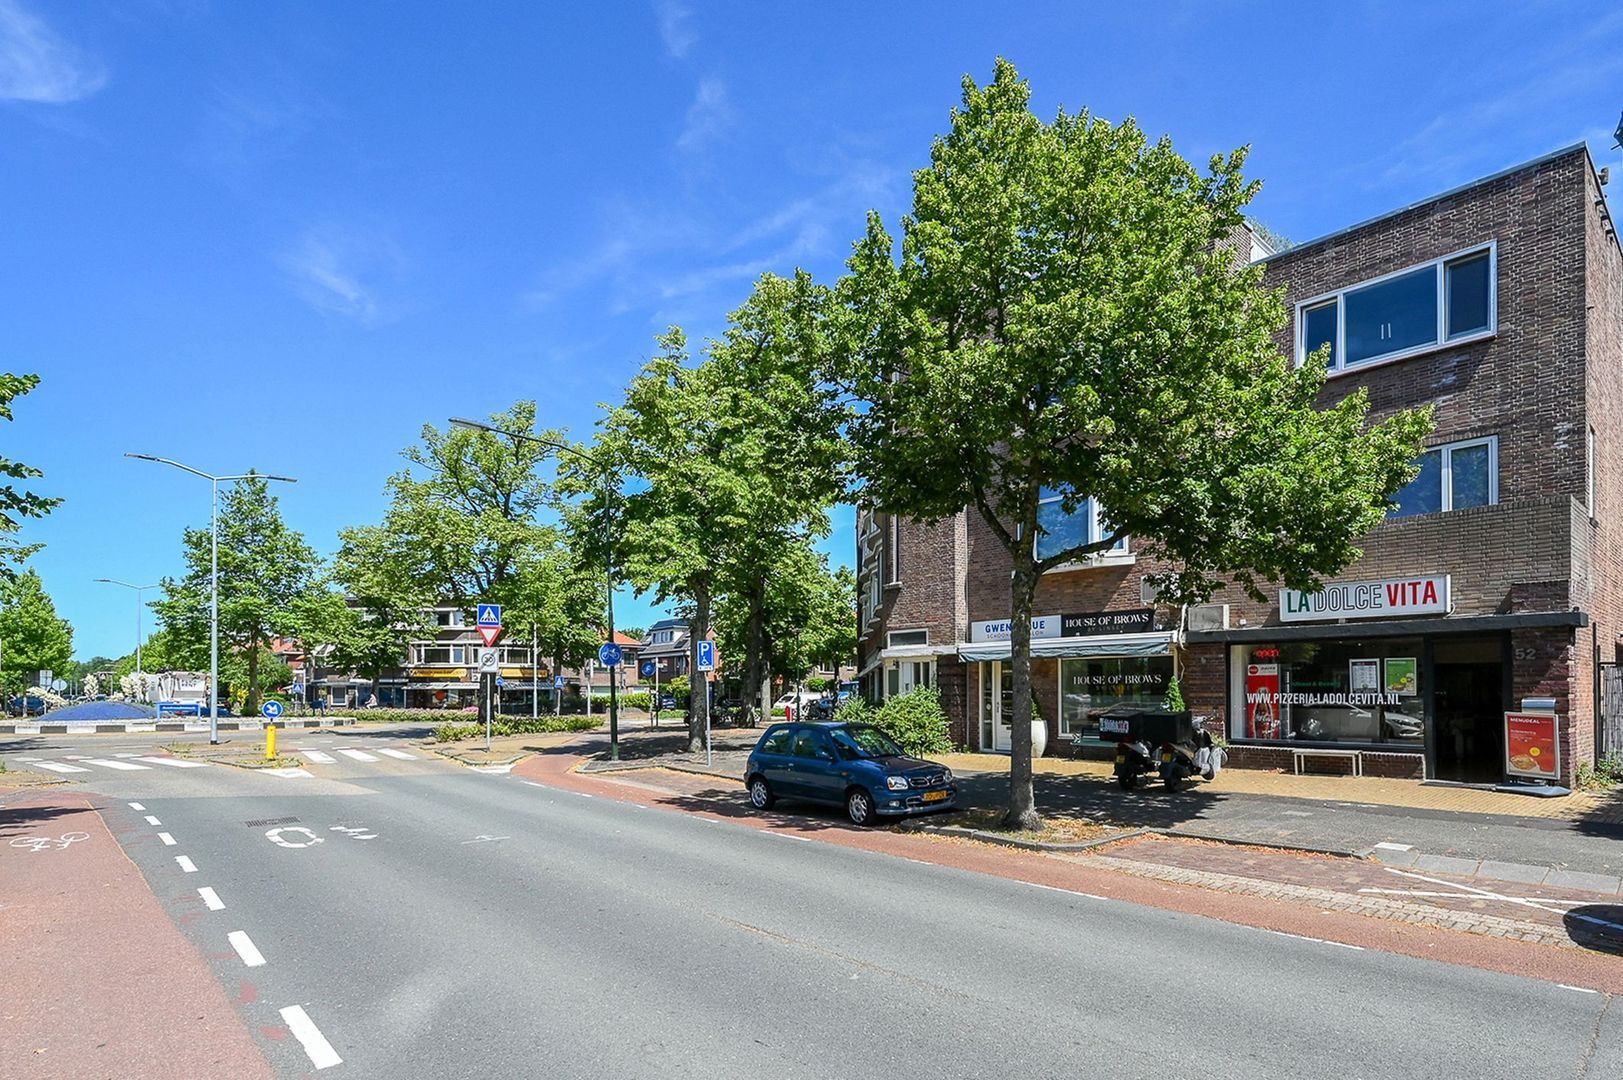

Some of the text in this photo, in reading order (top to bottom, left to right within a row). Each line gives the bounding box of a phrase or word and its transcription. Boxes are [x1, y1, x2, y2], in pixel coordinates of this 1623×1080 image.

[1287, 580, 1438, 613] LA DOLCE VITA
[1065, 613, 1149, 628] HOUSE OF BROWS
[701, 643, 710, 656] P
[1515, 648, 1537, 660] 52
[1073, 674, 1162, 685] HOUSE OF BROWS
[1247, 692, 1402, 705] WWW.PIZZERIA-LADOLCEVITA.NL
